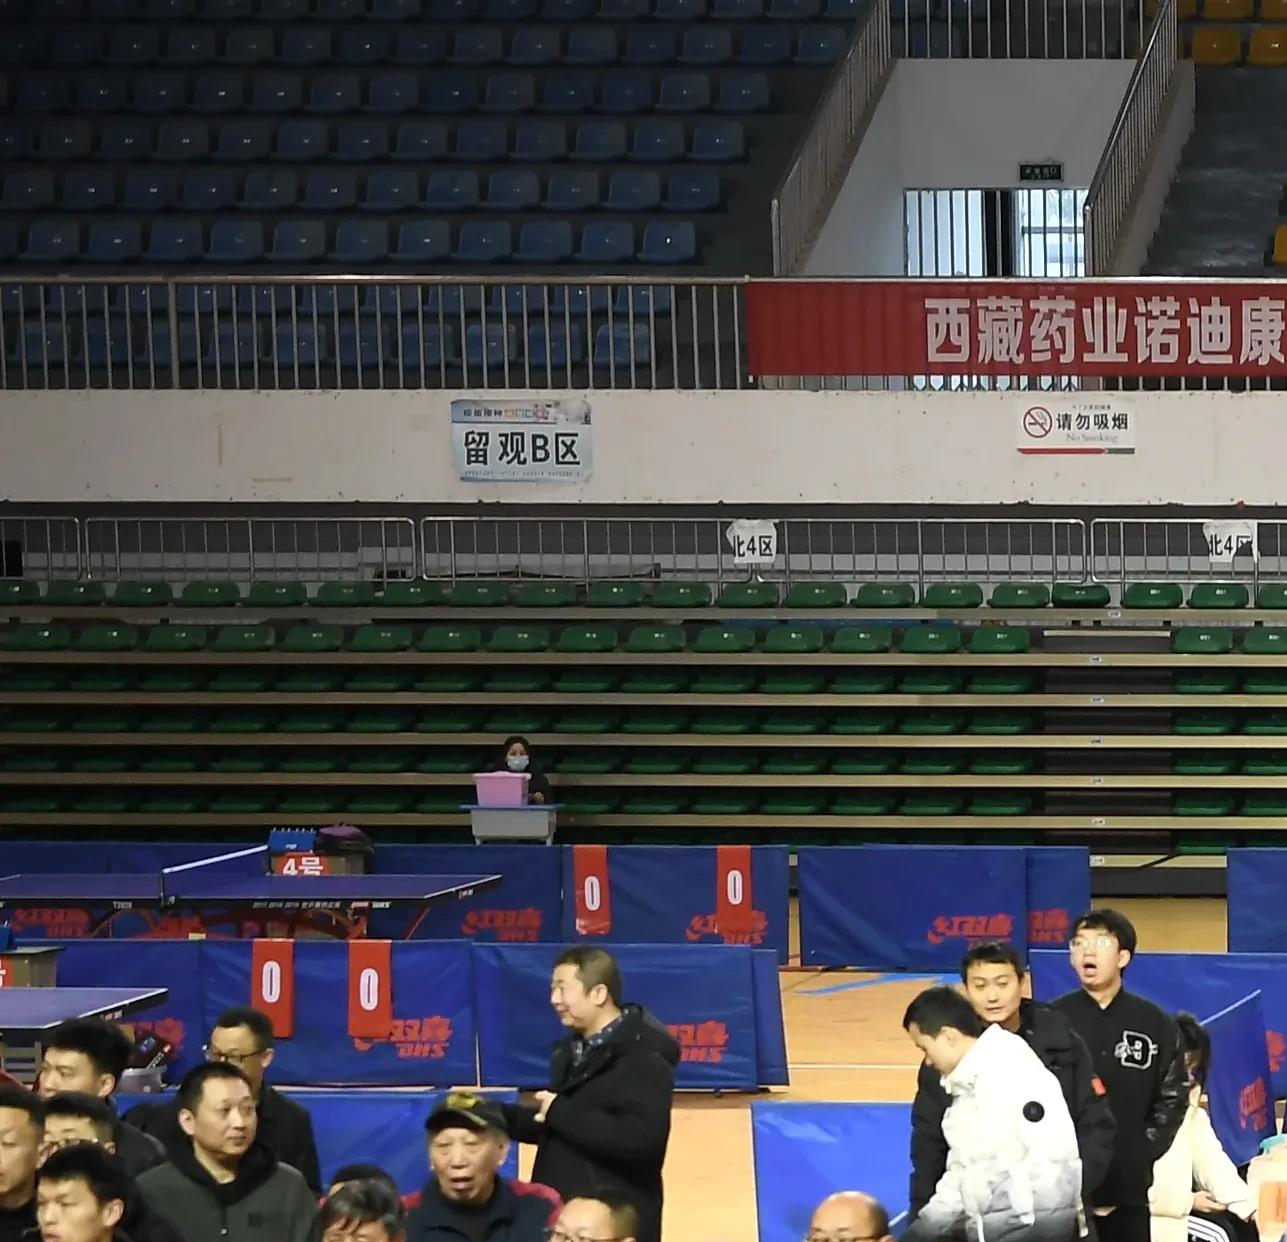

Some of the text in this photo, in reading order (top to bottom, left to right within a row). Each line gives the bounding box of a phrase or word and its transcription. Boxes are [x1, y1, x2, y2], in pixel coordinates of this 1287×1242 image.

[1057, 412, 1128, 430] 请勿吸烟
[464, 430, 580, 466] 留观B区
[282, 855, 323, 876] 4号
[585, 876, 600, 911] 0
[727, 869, 743, 905] 0
[262, 960, 281, 1004] 0
[359, 967, 379, 1012] 0
